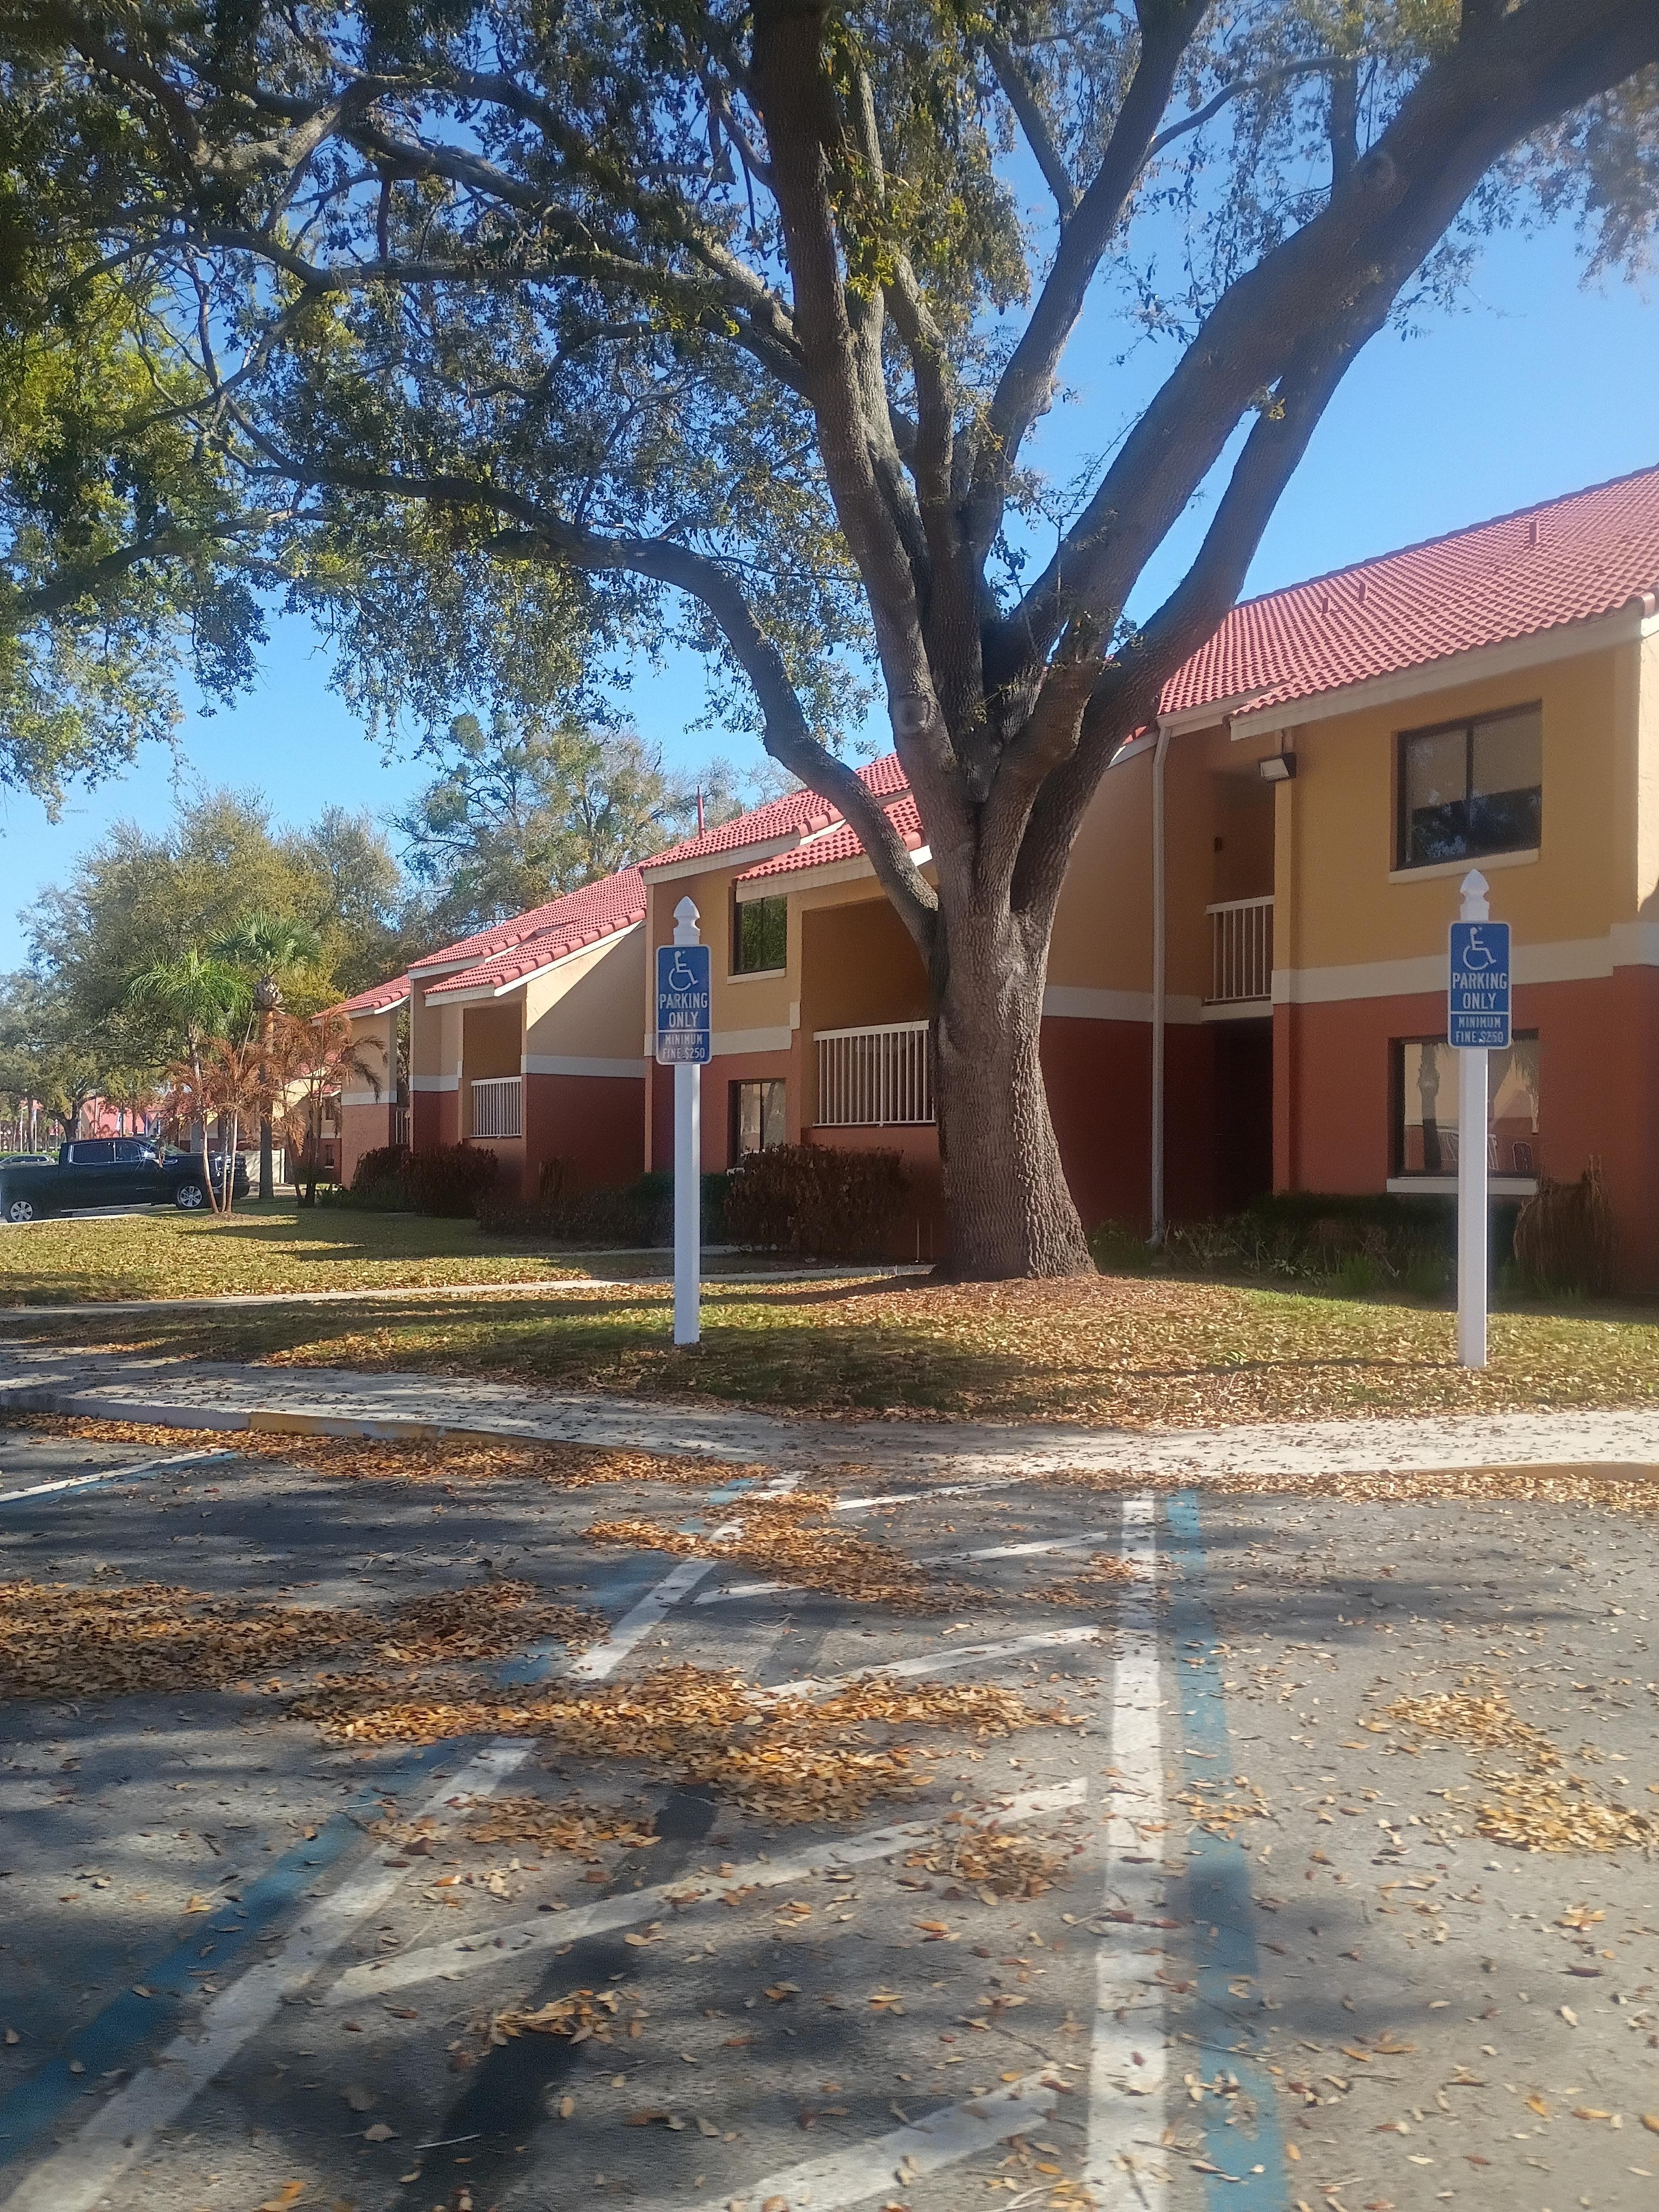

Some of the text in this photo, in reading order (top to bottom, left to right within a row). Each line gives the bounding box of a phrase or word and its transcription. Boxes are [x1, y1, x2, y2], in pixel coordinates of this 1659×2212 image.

[1452, 973, 1507, 989] PARKING
[659, 993, 708, 1009] PARKING
[1462, 993, 1496, 1009] ONLY
[669, 1011, 699, 1028] ONLY
[1458, 1016, 1501, 1028] MINIMUM
[665, 1034, 703, 1045] MINIMUM
[1455, 1030, 1504, 1043] FINE $250
[662, 1047, 705, 1060] FINE $250
